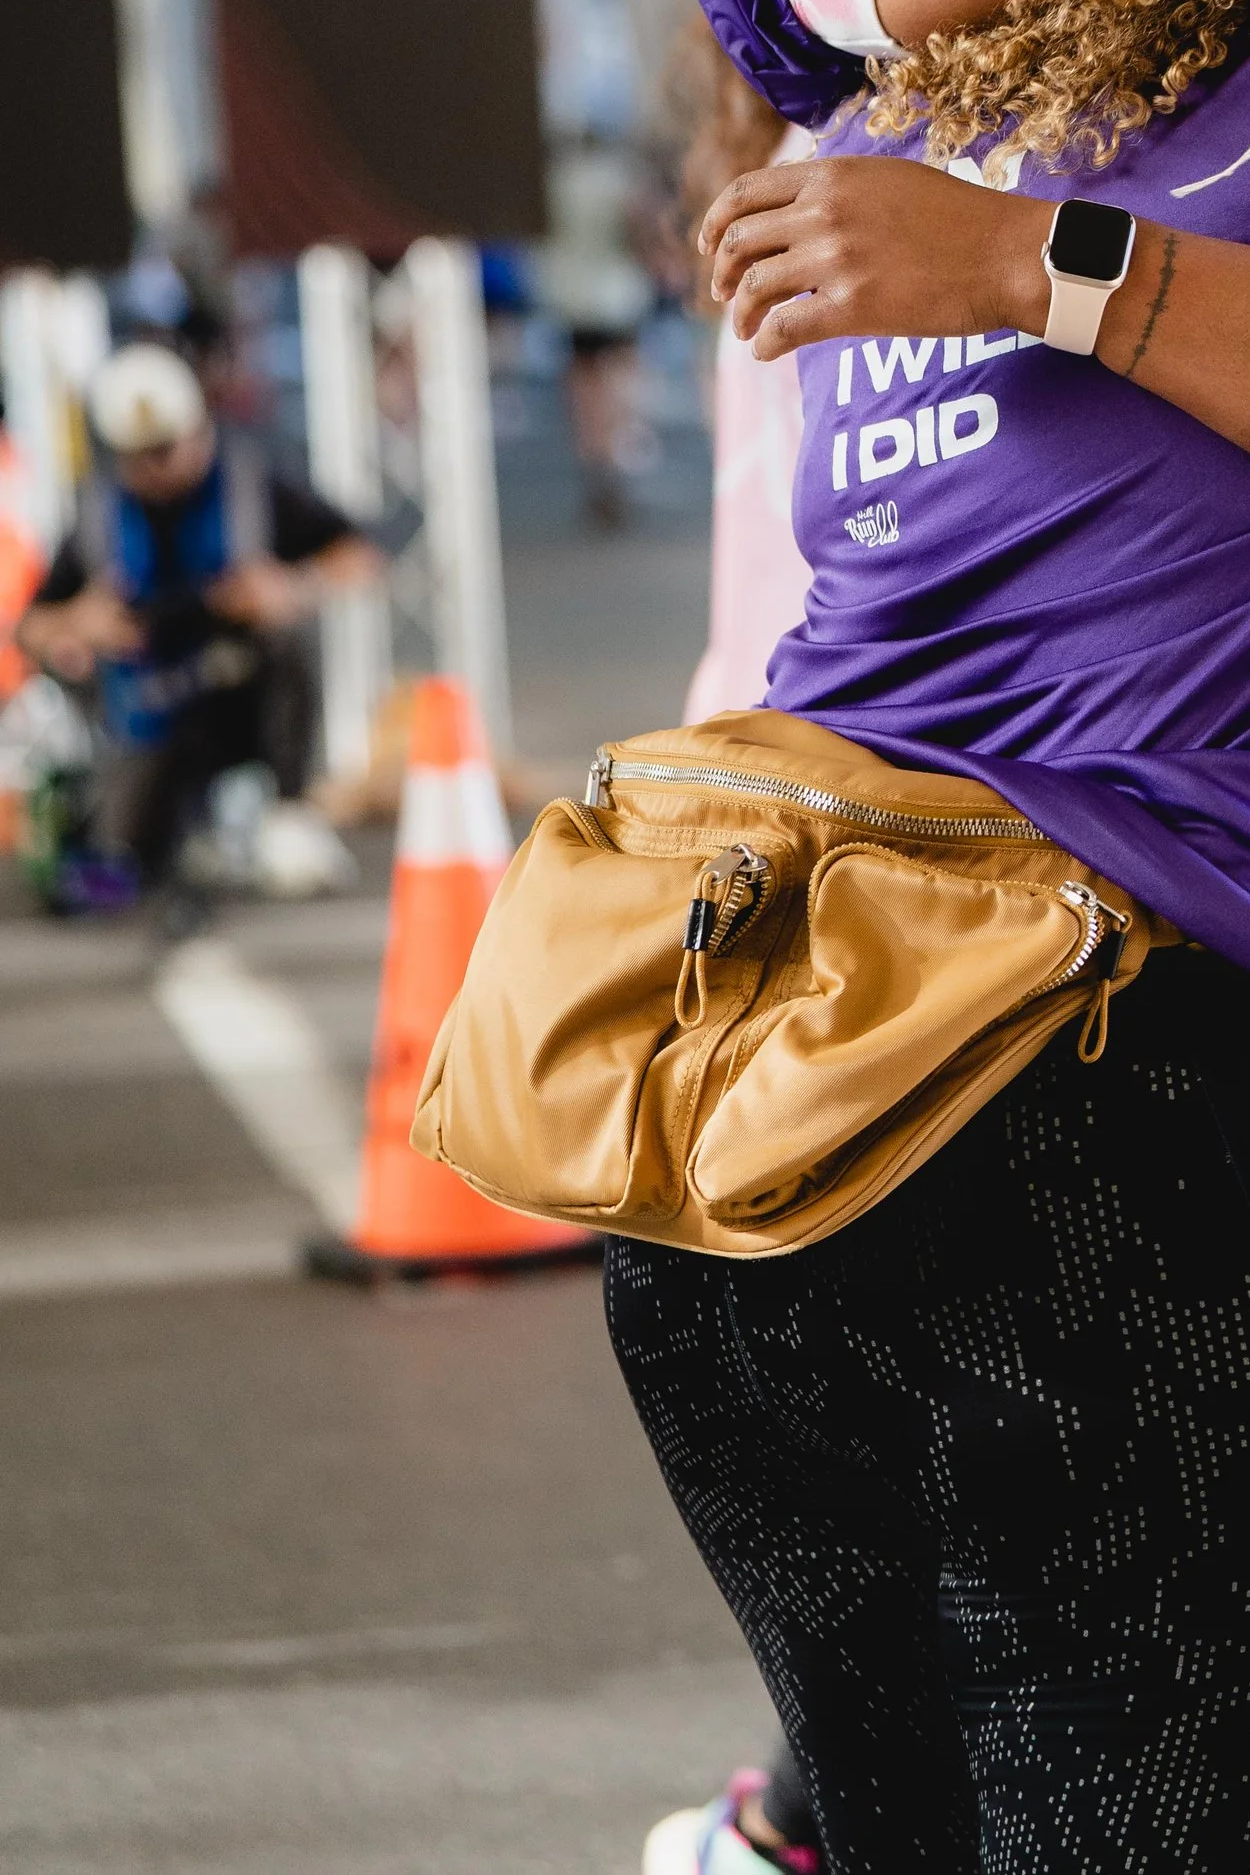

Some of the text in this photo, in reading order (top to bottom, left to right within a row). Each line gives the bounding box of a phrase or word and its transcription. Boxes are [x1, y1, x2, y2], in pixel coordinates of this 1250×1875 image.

[837, 331, 1044, 407] I WIL
[832, 393, 999, 492] I DID
[844, 518, 877, 543] Run
[867, 500, 900, 548] Club
